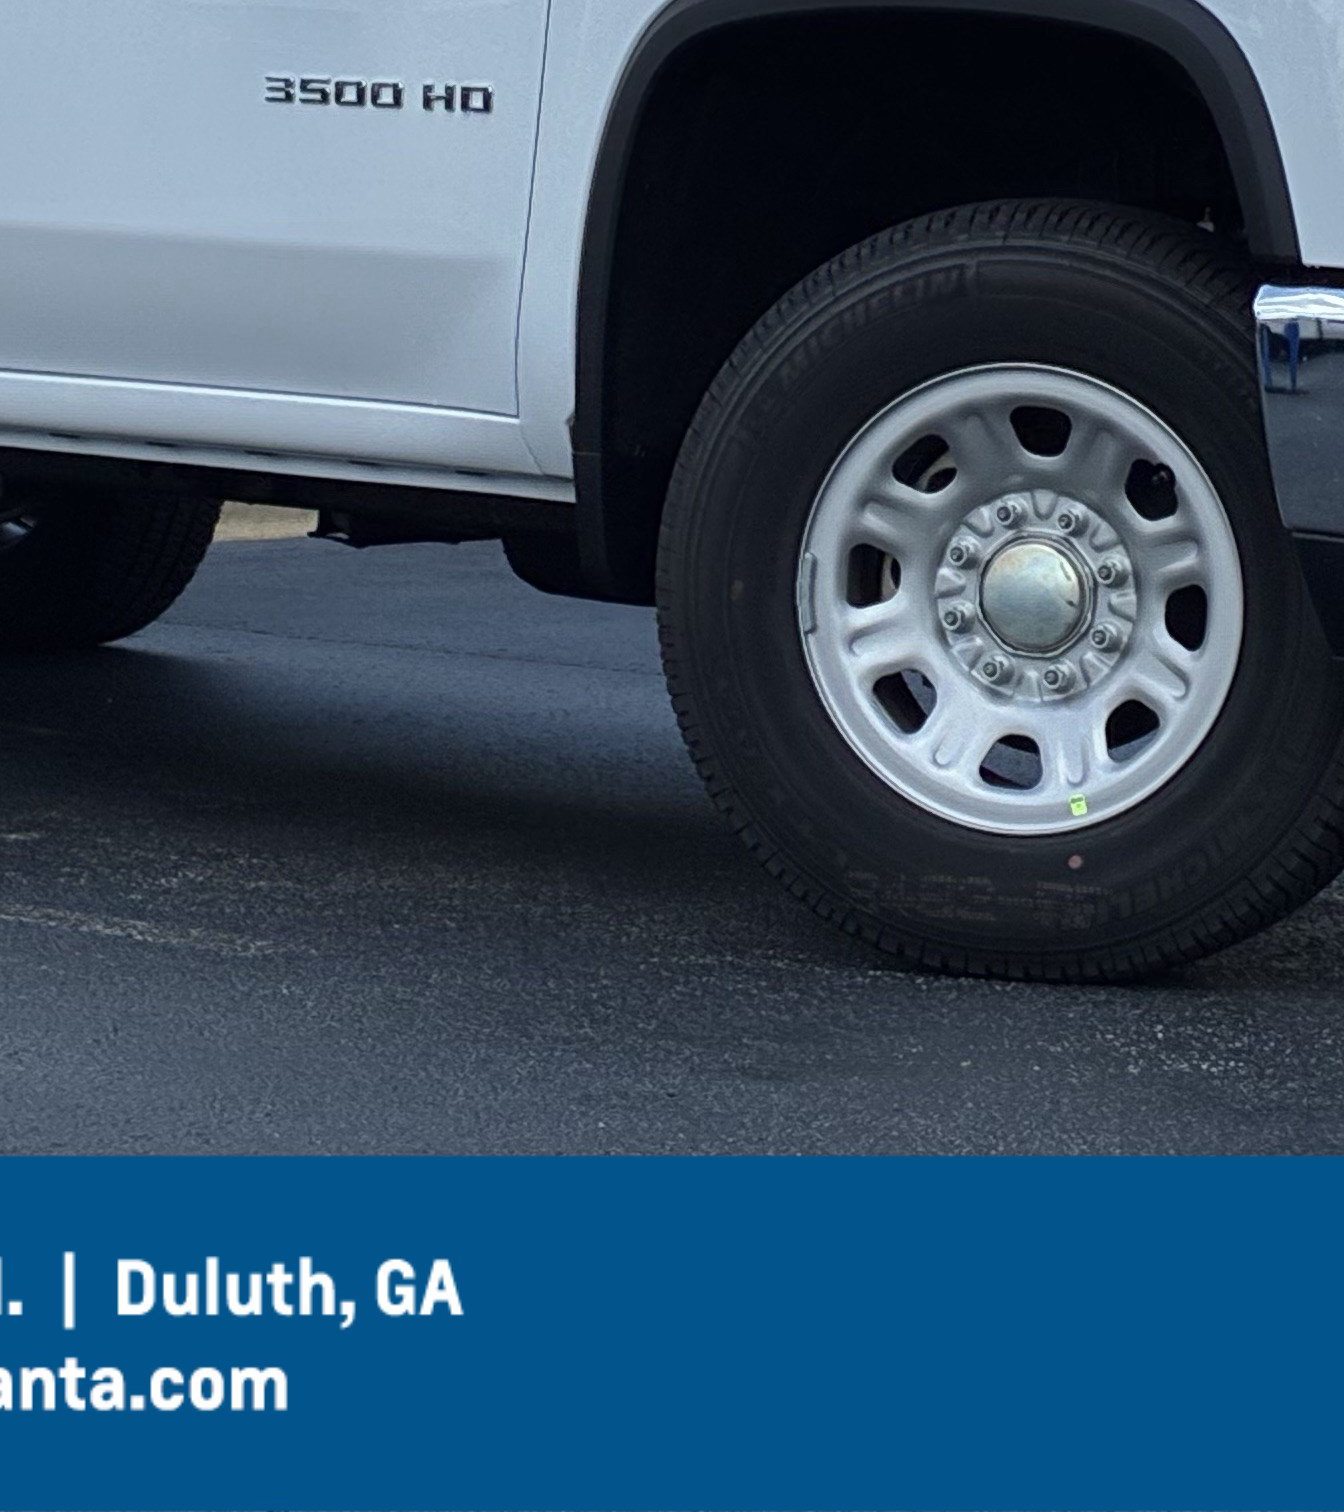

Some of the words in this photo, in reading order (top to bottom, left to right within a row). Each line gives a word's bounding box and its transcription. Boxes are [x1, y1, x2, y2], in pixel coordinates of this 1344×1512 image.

[264, 73, 404, 110] 3500
[422, 80, 496, 114] HD
[777, 263, 966, 391] MICHELIN
